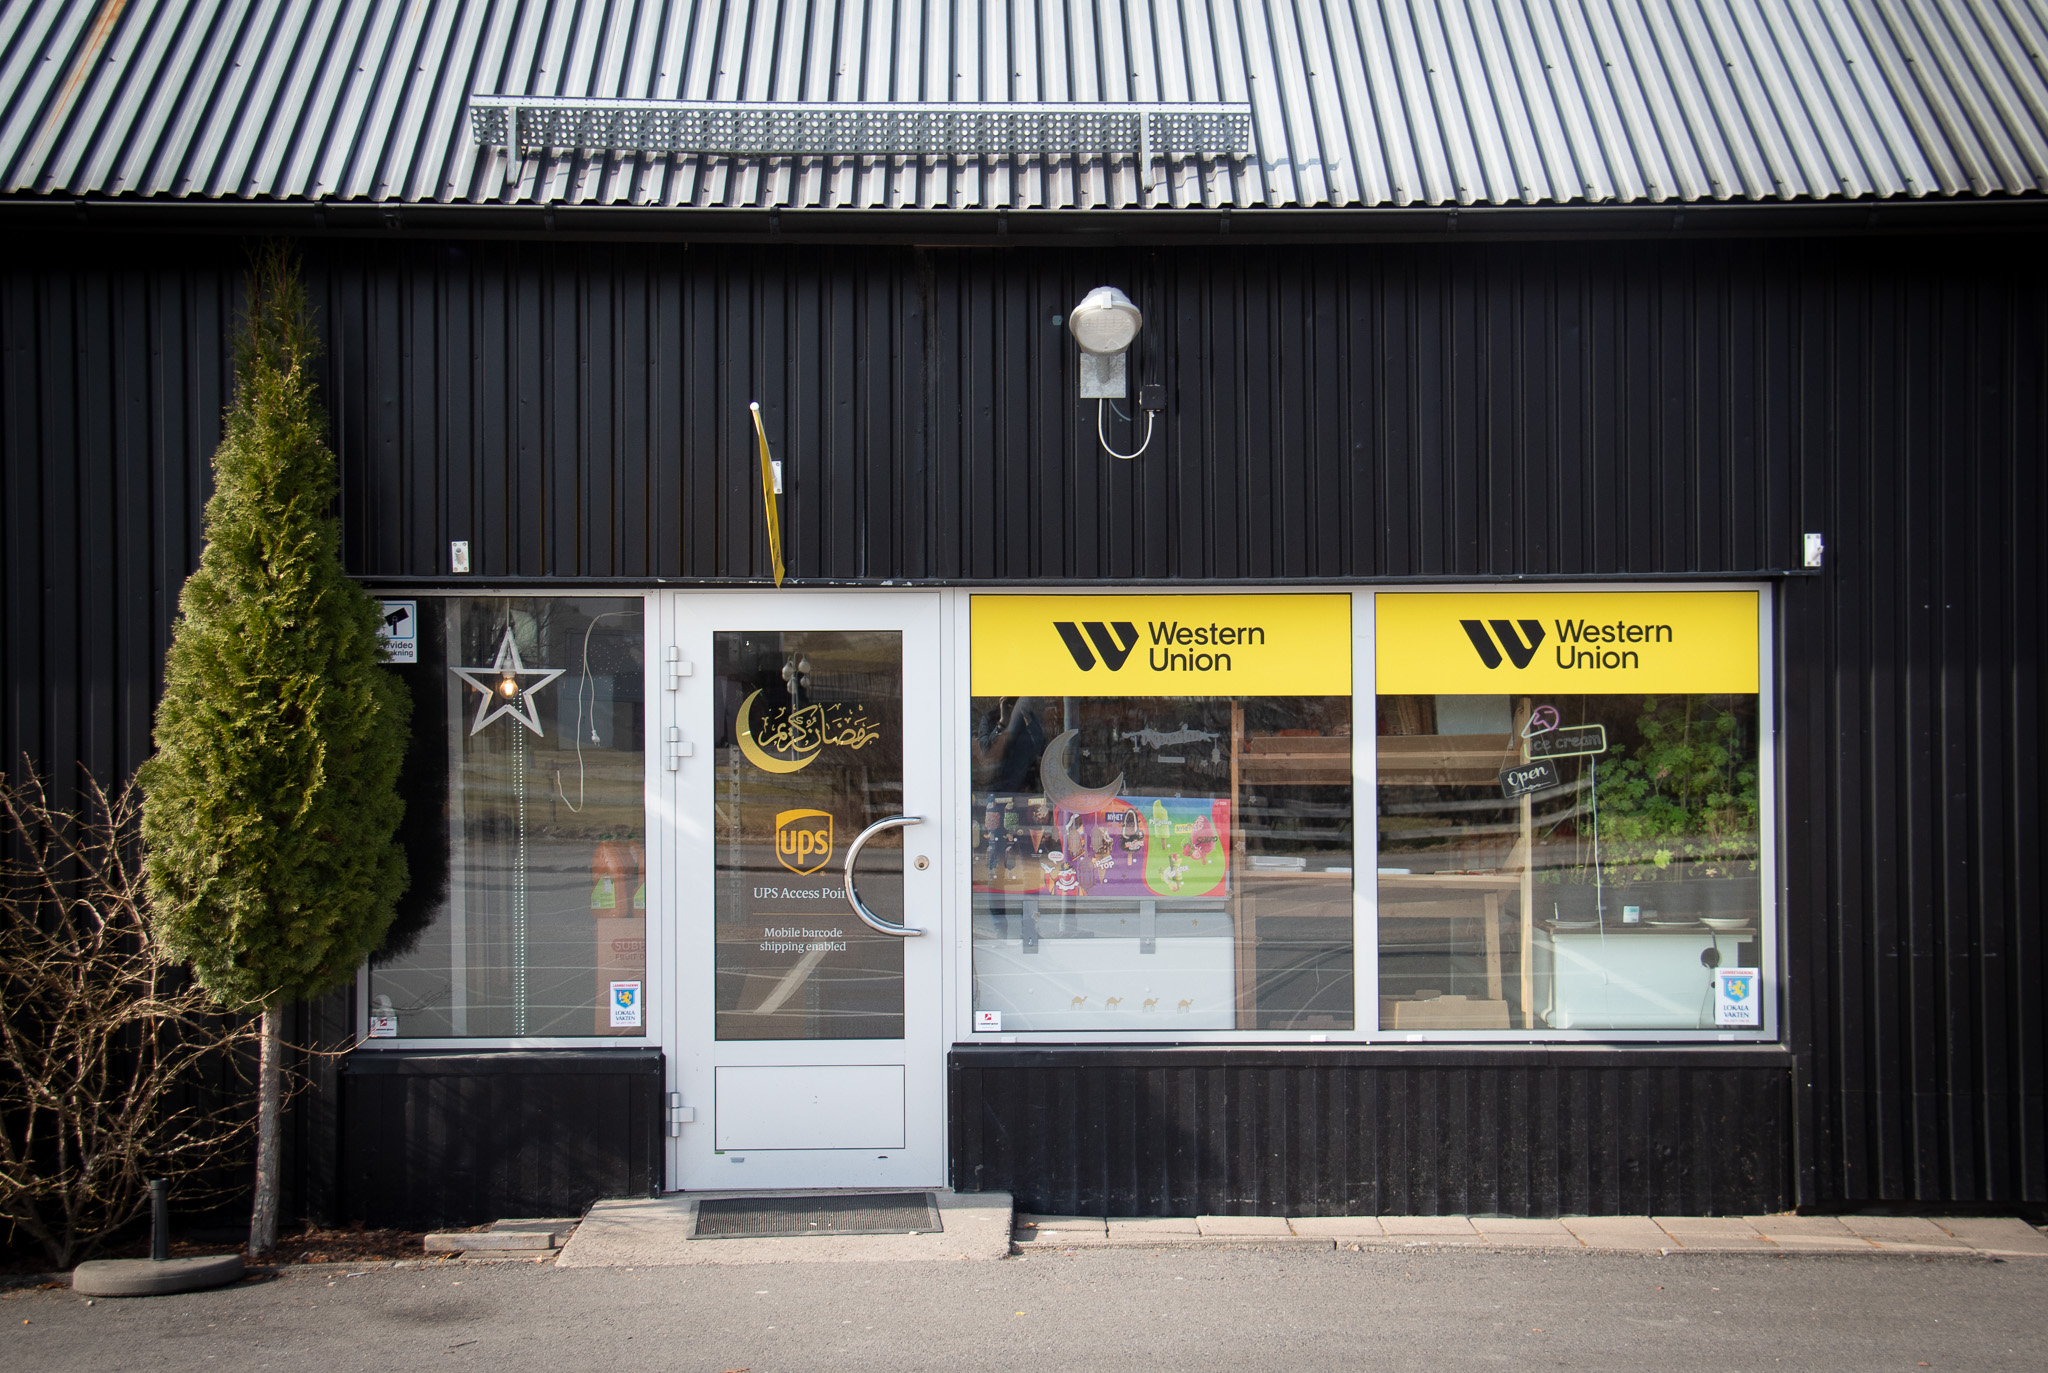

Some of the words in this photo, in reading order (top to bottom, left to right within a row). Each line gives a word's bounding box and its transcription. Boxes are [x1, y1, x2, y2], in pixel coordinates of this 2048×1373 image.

[1148, 622, 1265, 646] Western
[1555, 620, 1673, 643] Western
[1149, 648, 1231, 672] Union
[1556, 646, 1639, 669] Union
[1530, 739, 1552, 752] ice
[1555, 734, 1602, 750] cream
[1507, 766, 1549, 788] Open
[780, 830, 829, 865] ups
[753, 887, 778, 899] UPS
[781, 887, 820, 899] Access
[822, 887, 846, 899] Poi
[764, 927, 801, 938] Mobile
[802, 927, 843, 938] barcode
[760, 941, 804, 953] shipping
[806, 941, 847, 951] enabled
